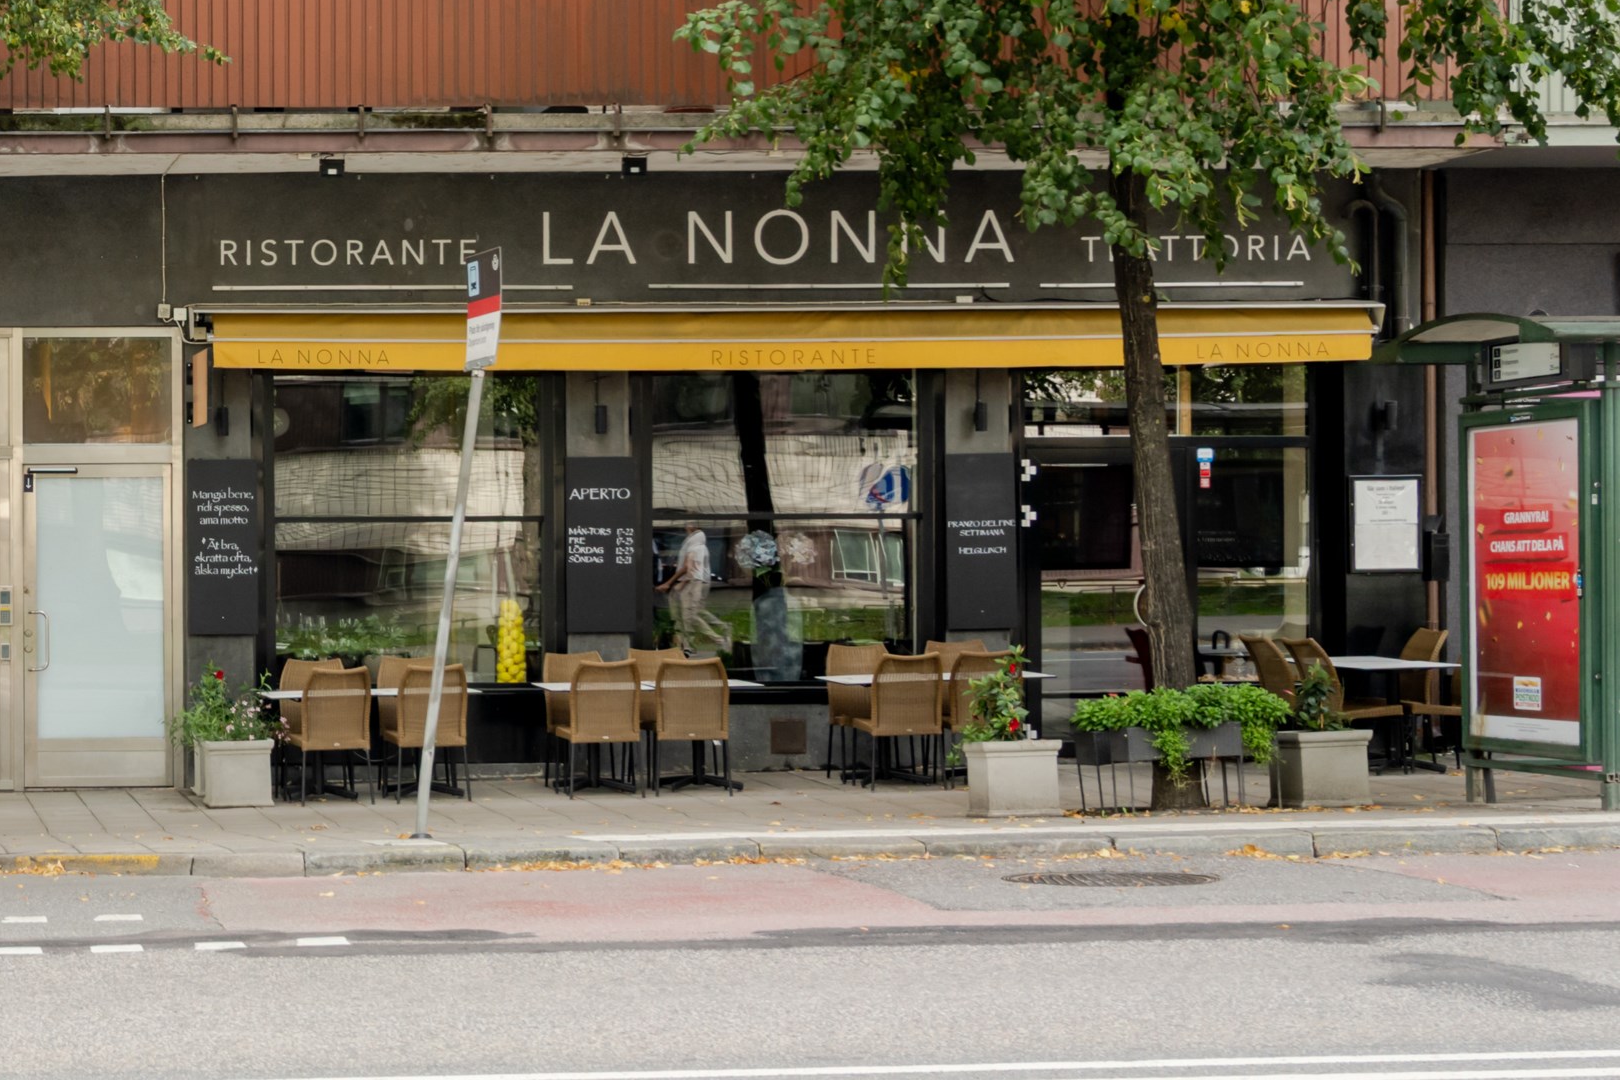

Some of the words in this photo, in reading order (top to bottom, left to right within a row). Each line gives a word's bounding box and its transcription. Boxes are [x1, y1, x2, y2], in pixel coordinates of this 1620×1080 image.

[542, 211, 637, 265] LA
[219, 239, 478, 266] RISTORANTE
[1196, 343, 1223, 359] LA
[1235, 341, 1330, 359] NONNA
[257, 349, 285, 365] LA
[298, 349, 390, 365] NONNA
[712, 348, 876, 366] RISTORANTE
[227, 487, 254, 500] bene,
[569, 487, 631, 500] APERTO
[213, 504, 250, 517] spesso,
[947, 520, 981, 528] PRANZO
[1503, 510, 1549, 525] GRANNYRA!
[568, 525, 612, 536] MÅN-TORS
[959, 528, 1005, 537] SETTIMANA
[220, 538, 240, 550] bra,
[568, 537, 586, 545] FRE
[1490, 540, 1516, 553] CHANS
[1516, 540, 1532, 552] ATT
[1532, 539, 1553, 552] DELA
[1553, 535, 1564, 551] PÅ
[568, 545, 605, 554] LÖRDAG
[194, 551, 228, 562] skratta
[229, 550, 252, 563] ofta,
[568, 554, 604, 564] SÖNDAG
[1485, 572, 1506, 590] 109
[1507, 571, 1570, 590] MILJONER
